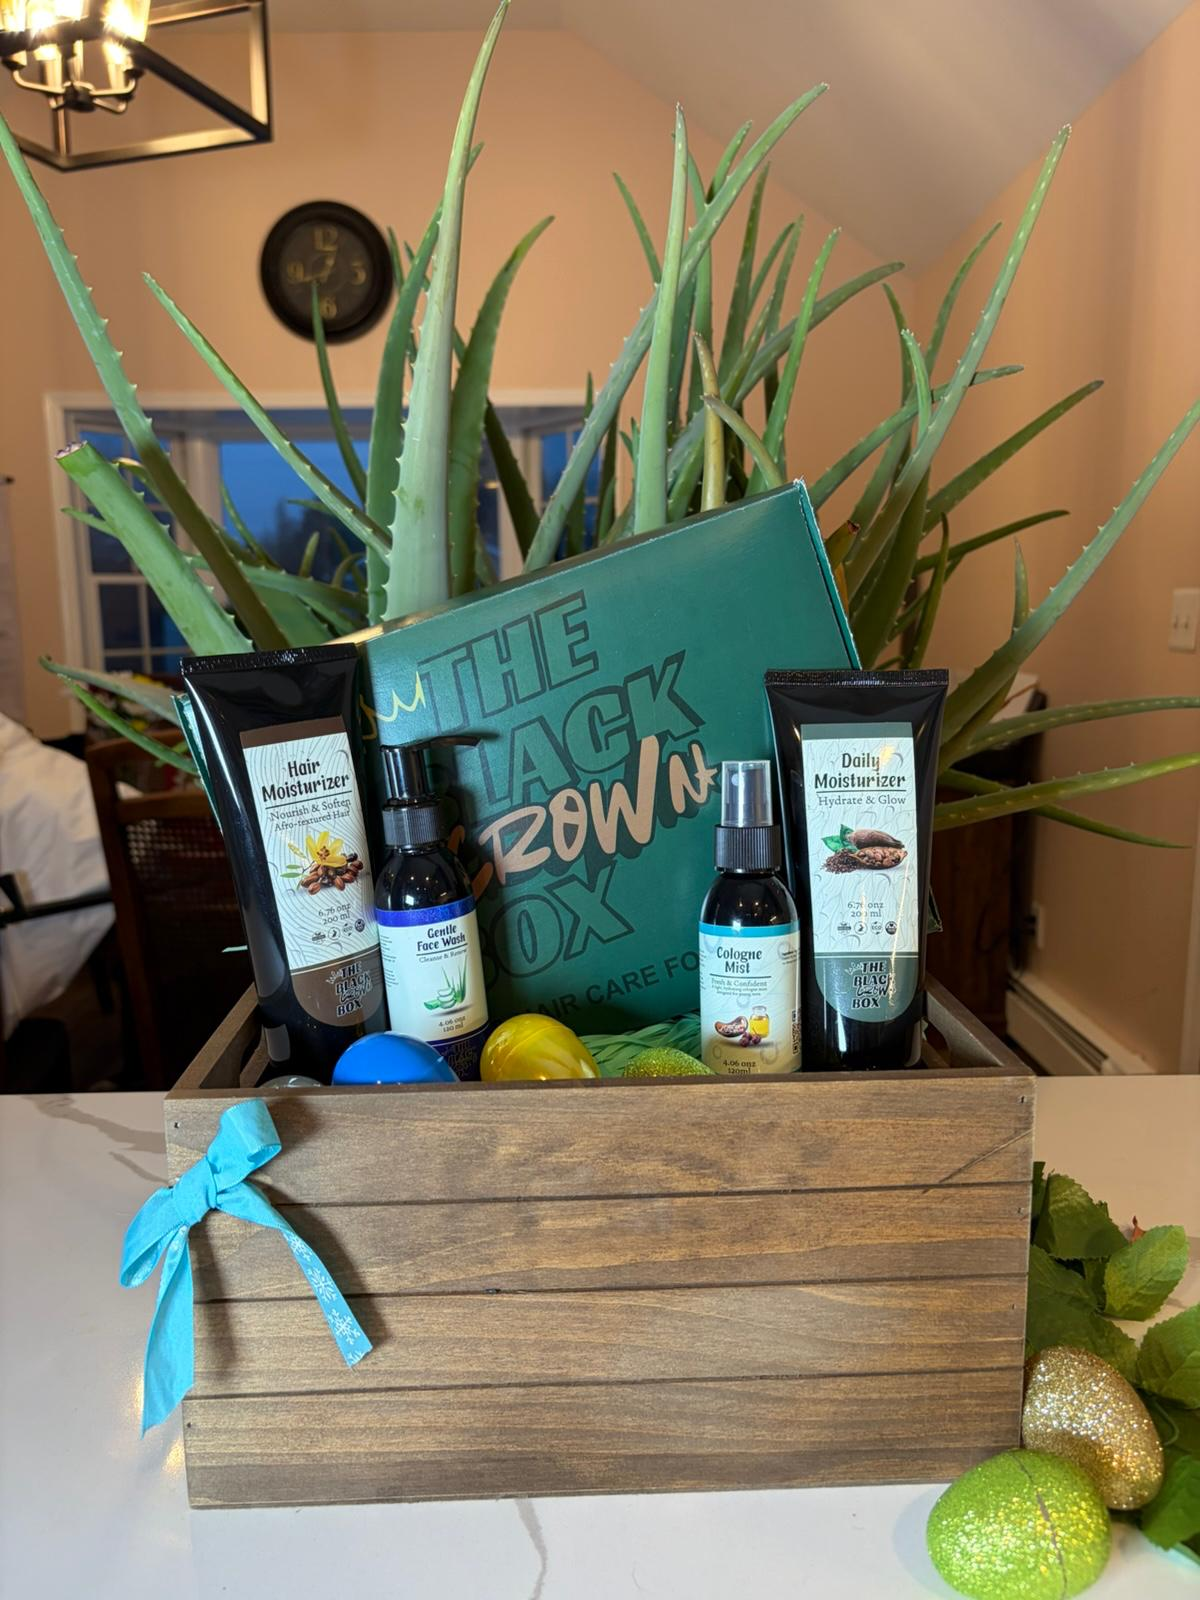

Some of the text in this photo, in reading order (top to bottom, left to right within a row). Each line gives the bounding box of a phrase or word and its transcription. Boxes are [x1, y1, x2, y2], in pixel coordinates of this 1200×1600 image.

[416, 589, 600, 738] THE
[455, 649, 706, 815] LACK
[287, 759, 320, 778] Hair
[842, 753, 880, 771] Daily
[262, 773, 350, 803] Moisturizer
[814, 773, 906, 789] Moisturizer
[819, 794, 906, 808] Hydrate & Glow
[270, 798, 351, 822] Nourish & Soften
[274, 808, 351, 832] Afro-textured Hair
[870, 909, 882, 918] ml
[427, 924, 457, 938] Gentle
[480, 861, 635, 988] OX
[417, 933, 466, 952] Face Wash
[717, 946, 762, 963] Cologne
[341, 961, 362, 978] THE
[725, 962, 751, 974] Mist
[861, 961, 887, 974] THE
[530, 993, 577, 1018] AIR
[585, 964, 660, 1004] CARE
[733, 979, 767, 987] Confident
[336, 1000, 362, 1017] BOX
[852, 997, 880, 1009] BOX
[722, 1060, 740, 1068] 4.06
